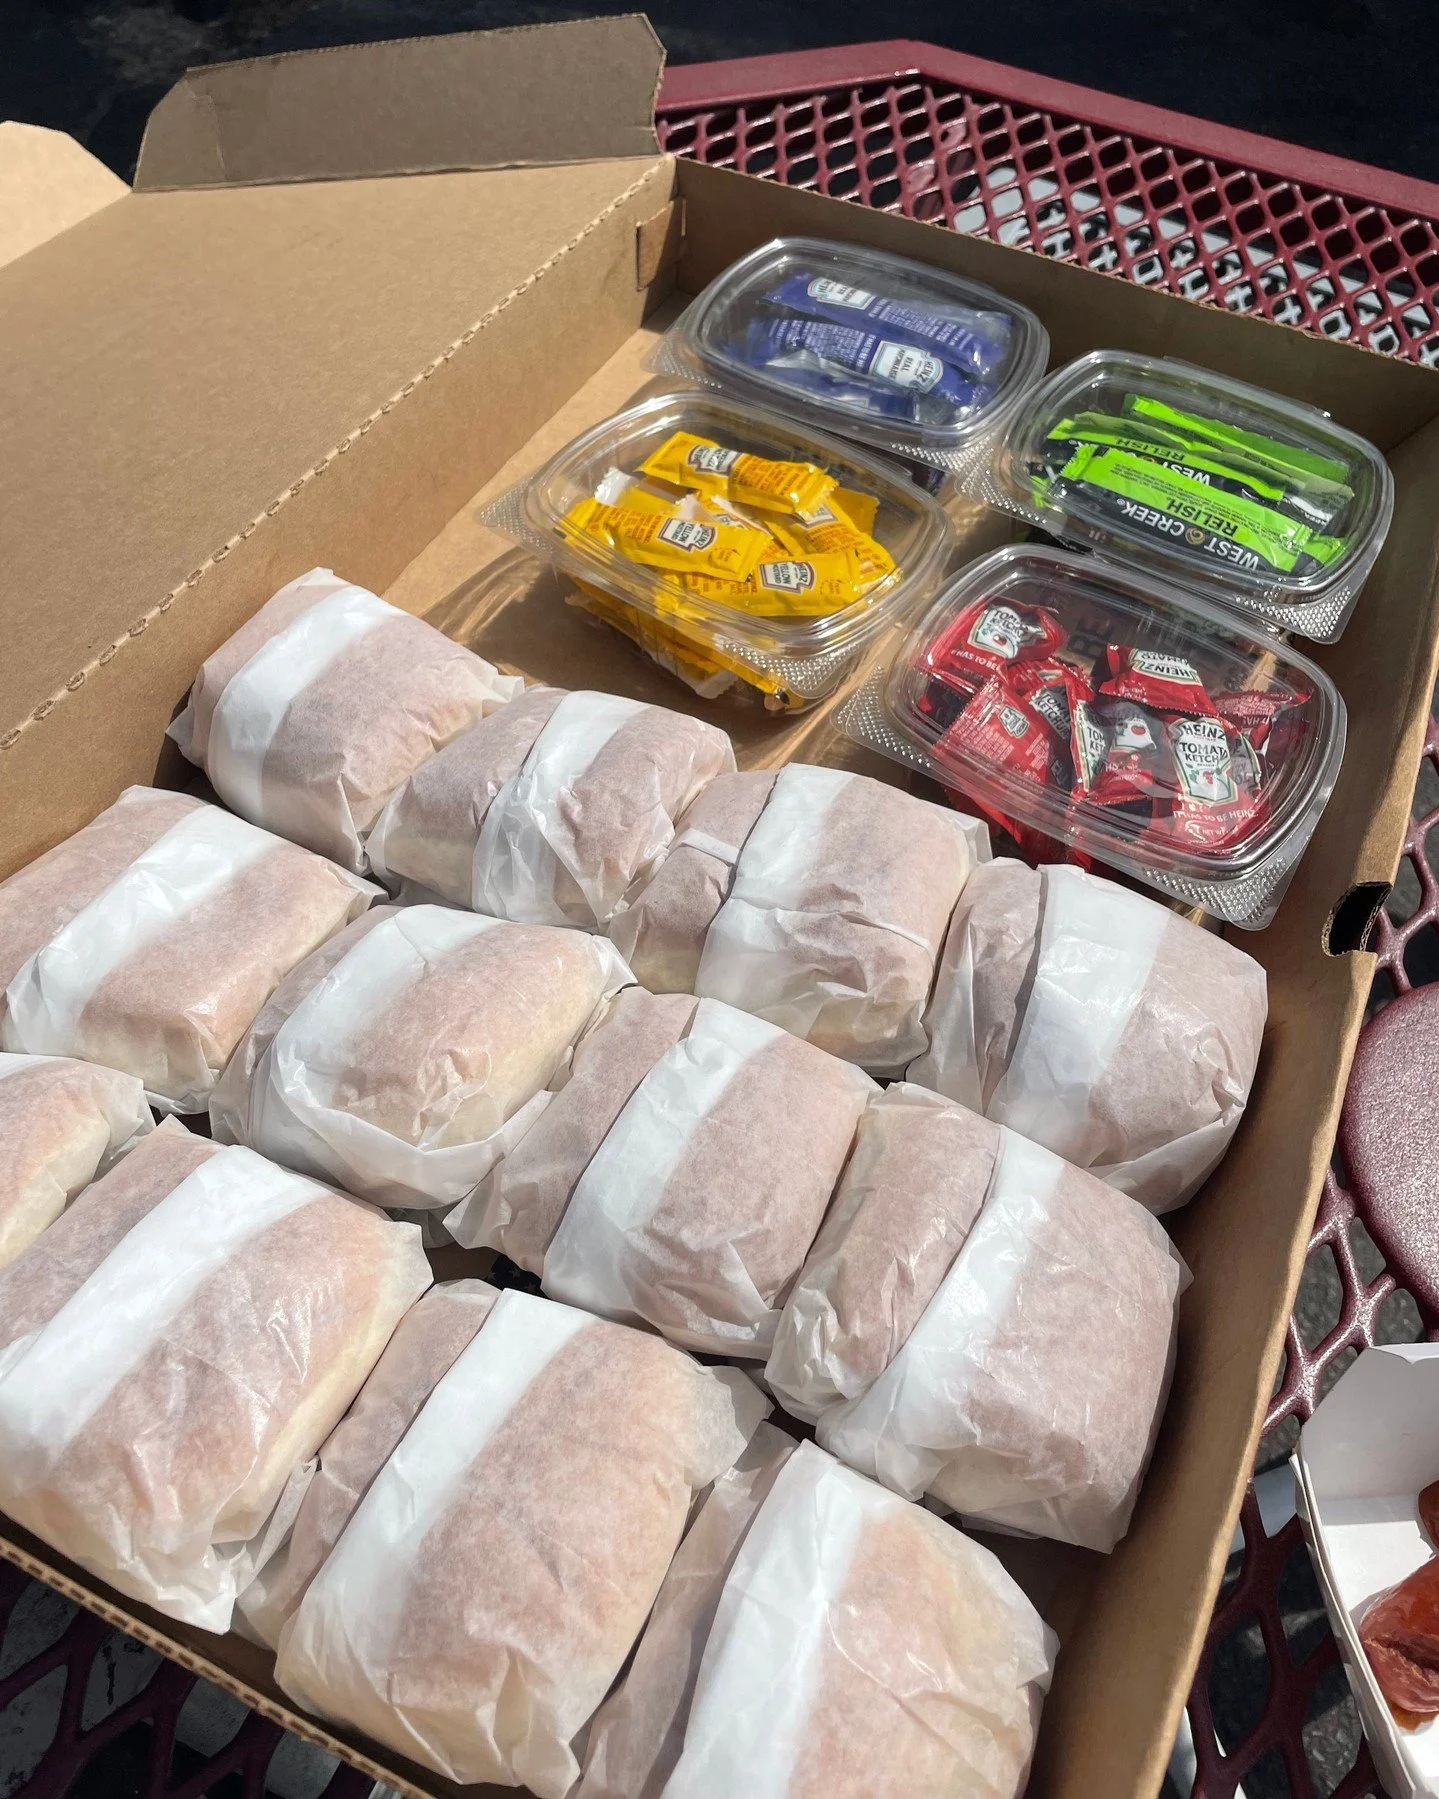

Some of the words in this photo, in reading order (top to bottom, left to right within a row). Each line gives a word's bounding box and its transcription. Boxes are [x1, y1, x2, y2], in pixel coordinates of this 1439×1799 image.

[1116, 438, 1185, 461] RELISH
[1166, 499, 1239, 538] RELISH
[679, 522, 696, 543] YELLOW
[695, 526, 710, 546] HEINZ
[1204, 537, 1259, 570] WEST
[1145, 661, 1190, 678] HEINZ
[1182, 724, 1226, 740] HEINZ
[1185, 753, 1219, 763] KETCH
